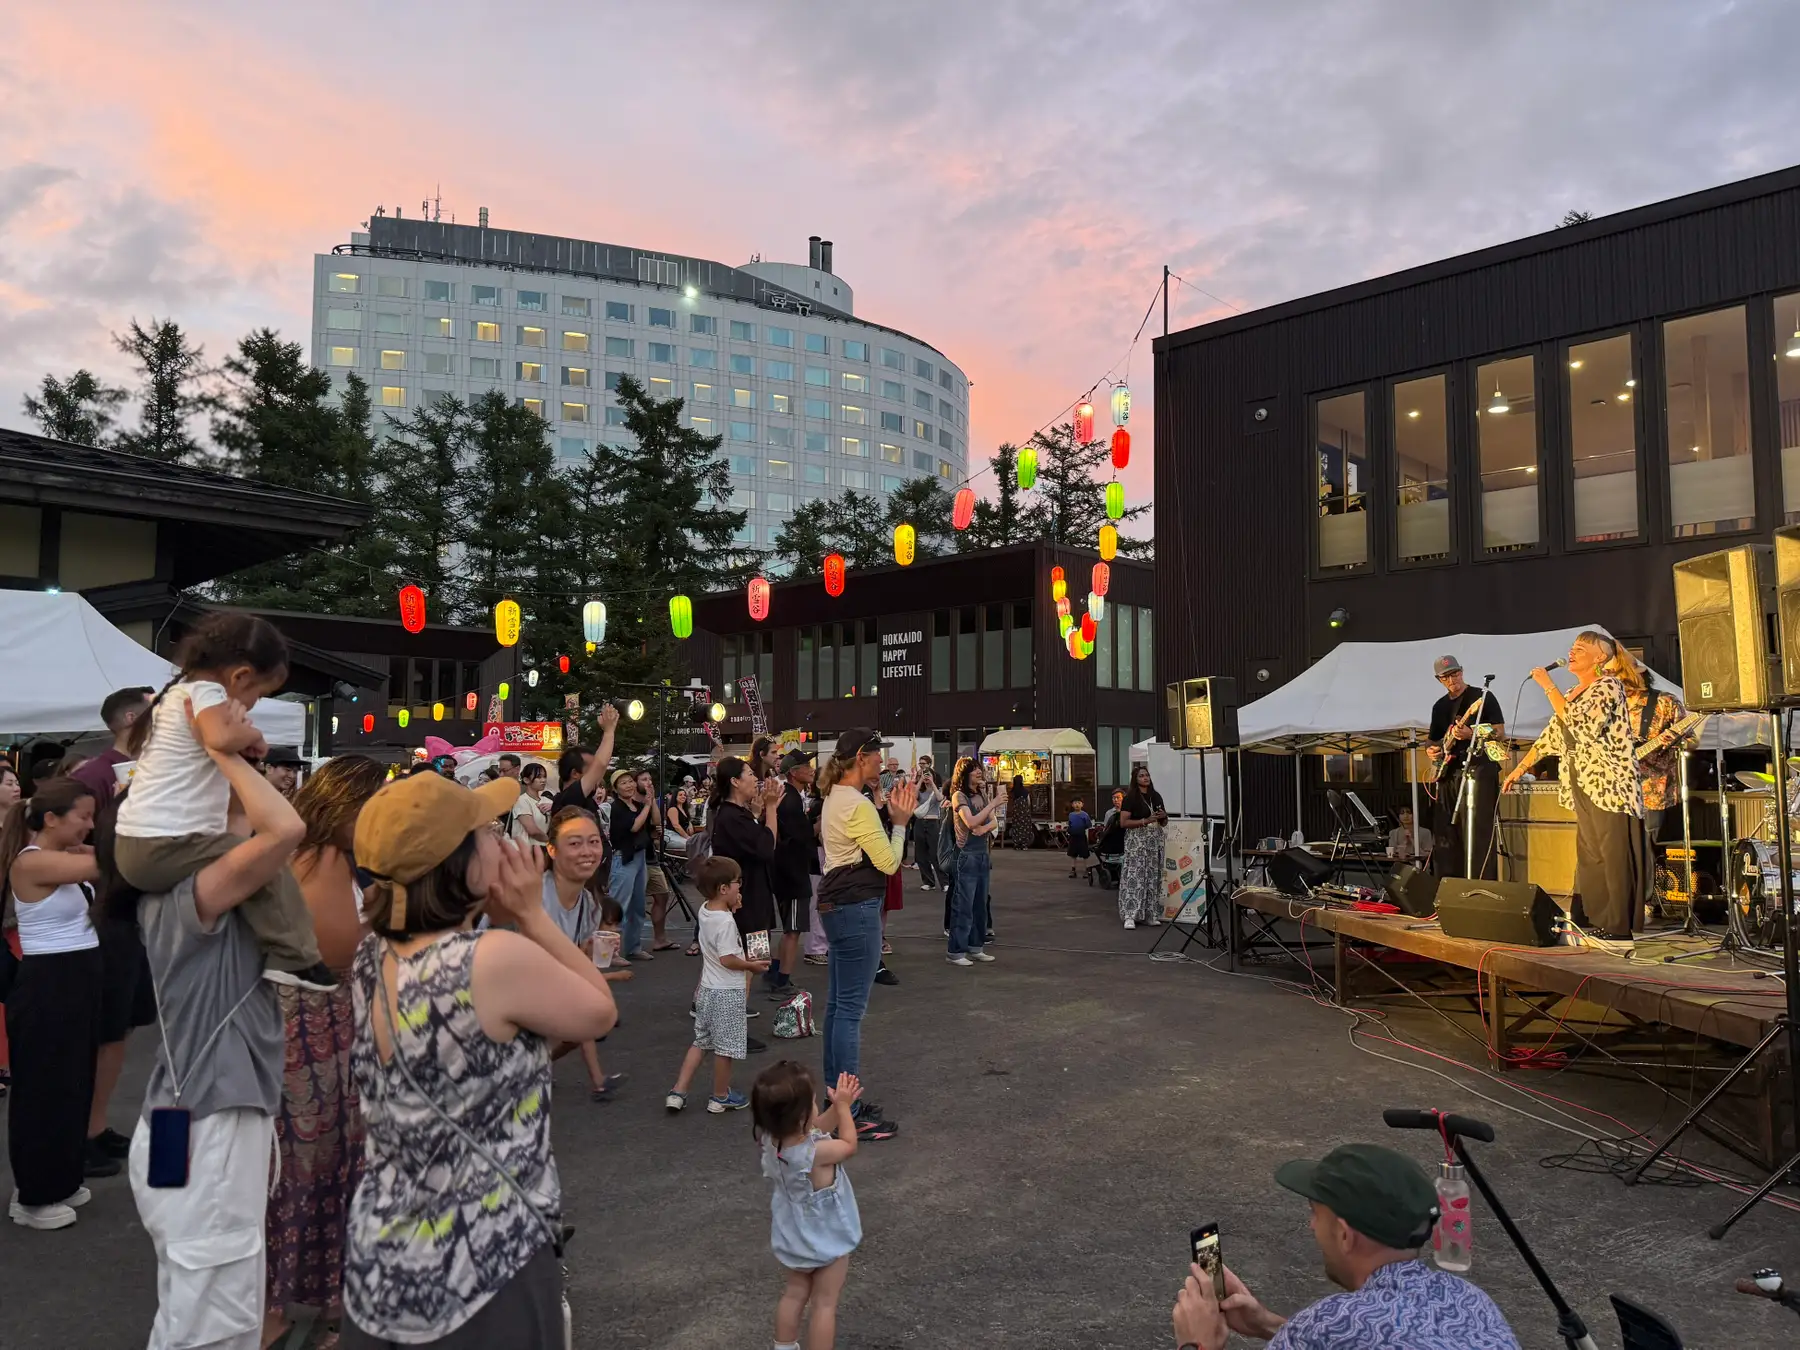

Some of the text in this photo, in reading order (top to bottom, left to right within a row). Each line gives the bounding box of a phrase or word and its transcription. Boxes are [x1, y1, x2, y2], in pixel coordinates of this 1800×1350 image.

[405, 593, 416, 627] 新雪谷
[752, 584, 761, 614] 新雪谷
[507, 606, 516, 640] 新雪谷
[882, 630, 922, 646] HOKKAIDO
[882, 648, 907, 662] HAPPY
[882, 663, 922, 679] LIFESTYLE
[1742, 852, 1760, 877] Pear
